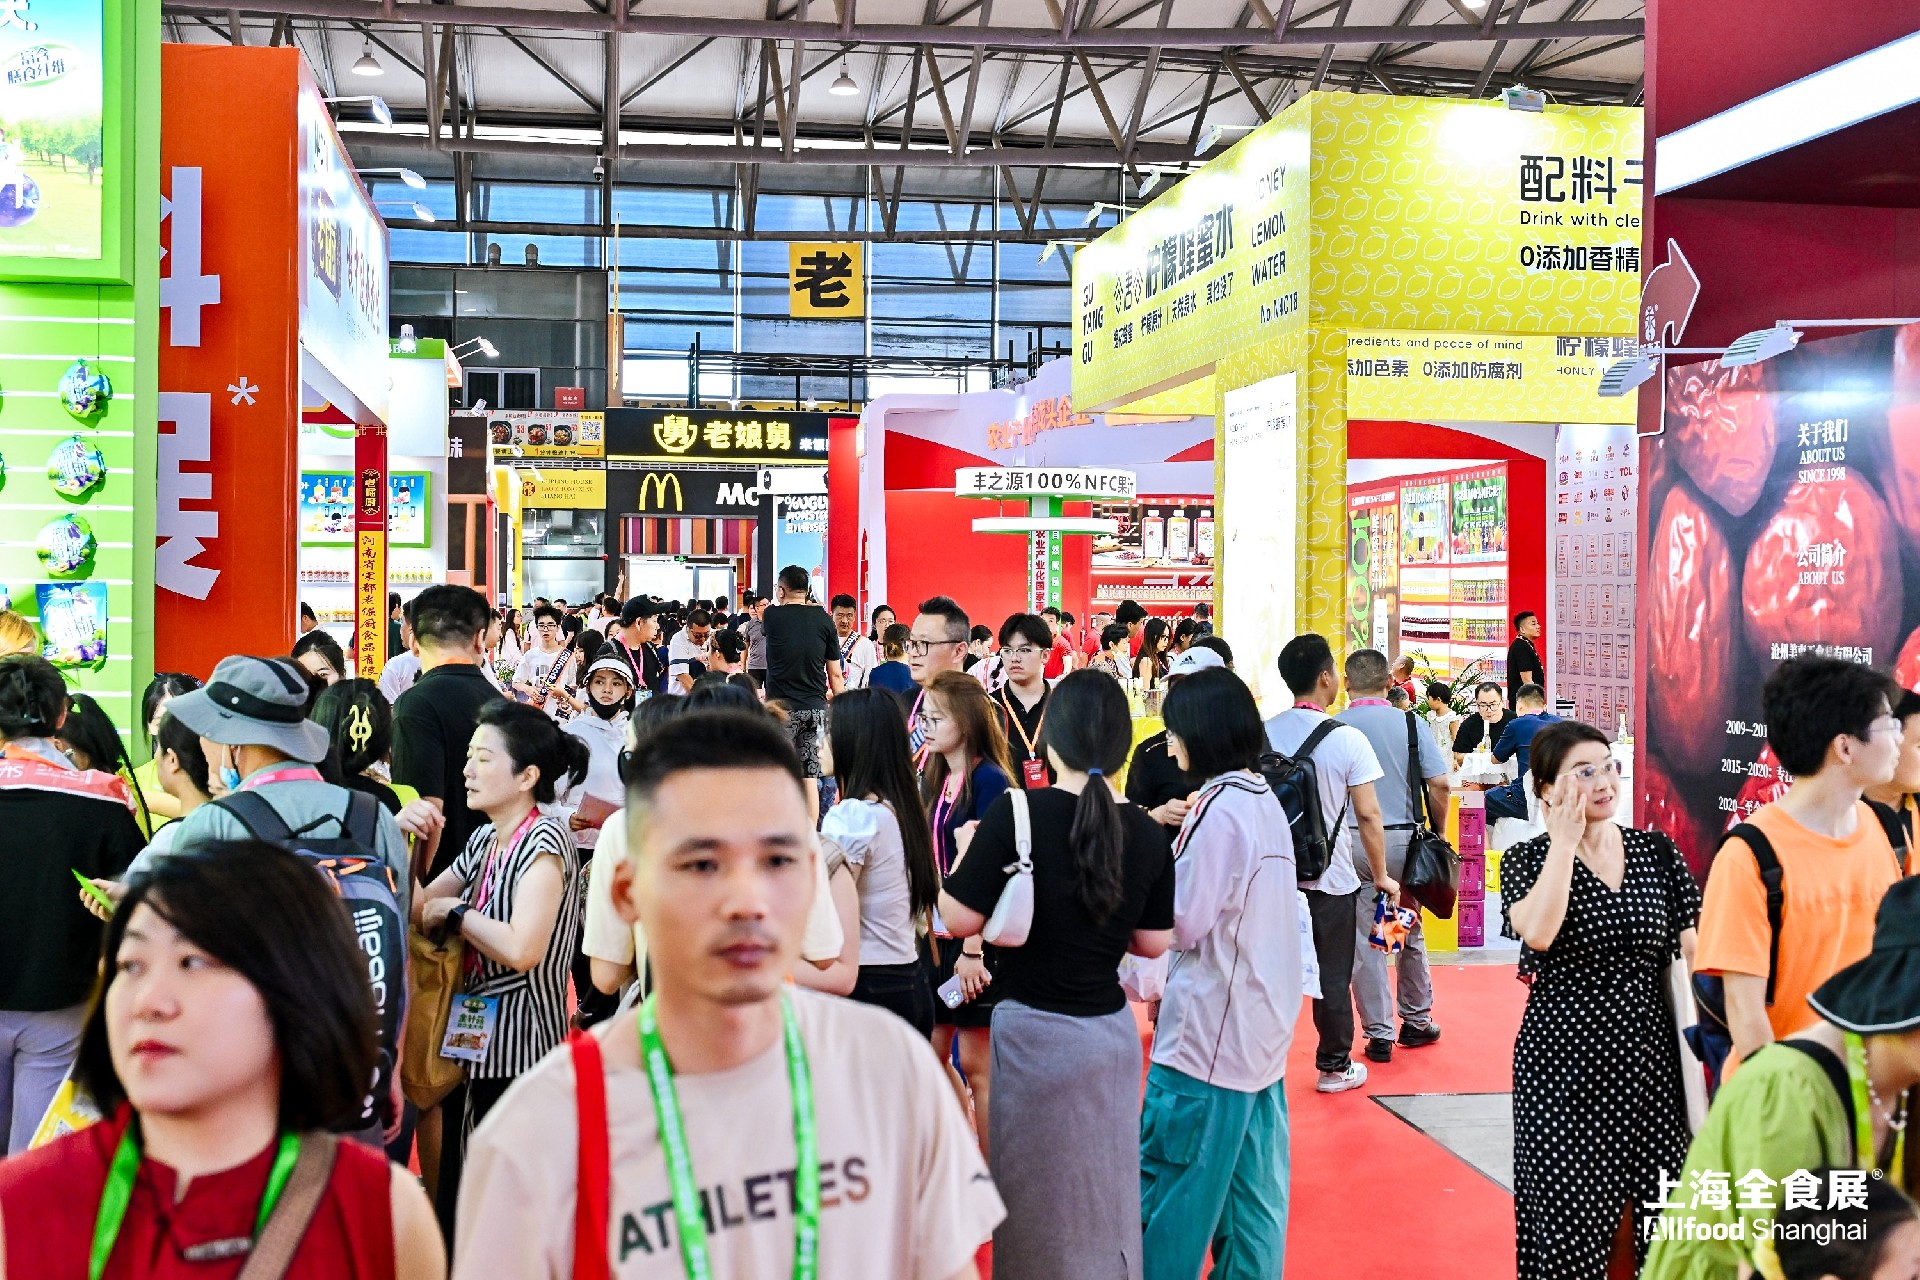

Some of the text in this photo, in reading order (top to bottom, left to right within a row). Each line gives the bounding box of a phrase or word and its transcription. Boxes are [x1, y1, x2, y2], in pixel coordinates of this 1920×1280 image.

[1520, 154, 1643, 204] 配料
[1251, 208, 1286, 248] LEMON
[1520, 210, 1563, 226] Drink
[1571, 212, 1608, 227] with
[1251, 250, 1286, 287] WATER
[1520, 244, 1640, 272] 0添加香精
[794, 251, 852, 307] 老
[1082, 305, 1104, 336] TANG
[1082, 340, 1093, 365] GU
[1406, 337, 1429, 347] and
[1477, 339, 1489, 349] of
[1494, 339, 1523, 350] mind
[1423, 360, 1523, 380] 0添加防腐剂
[703, 420, 792, 451] 老娘舅
[1797, 419, 1848, 447] 关于我们
[1799, 447, 1845, 464] ABOUT US
[973, 471, 1134, 495] 丰之源100%NFC果汁
[1620, 466, 1633, 476] TCL
[1799, 467, 1846, 484] SINCE 1998
[1796, 541, 1847, 567] 公司简介
[1798, 571, 1845, 585] ABOUT US
